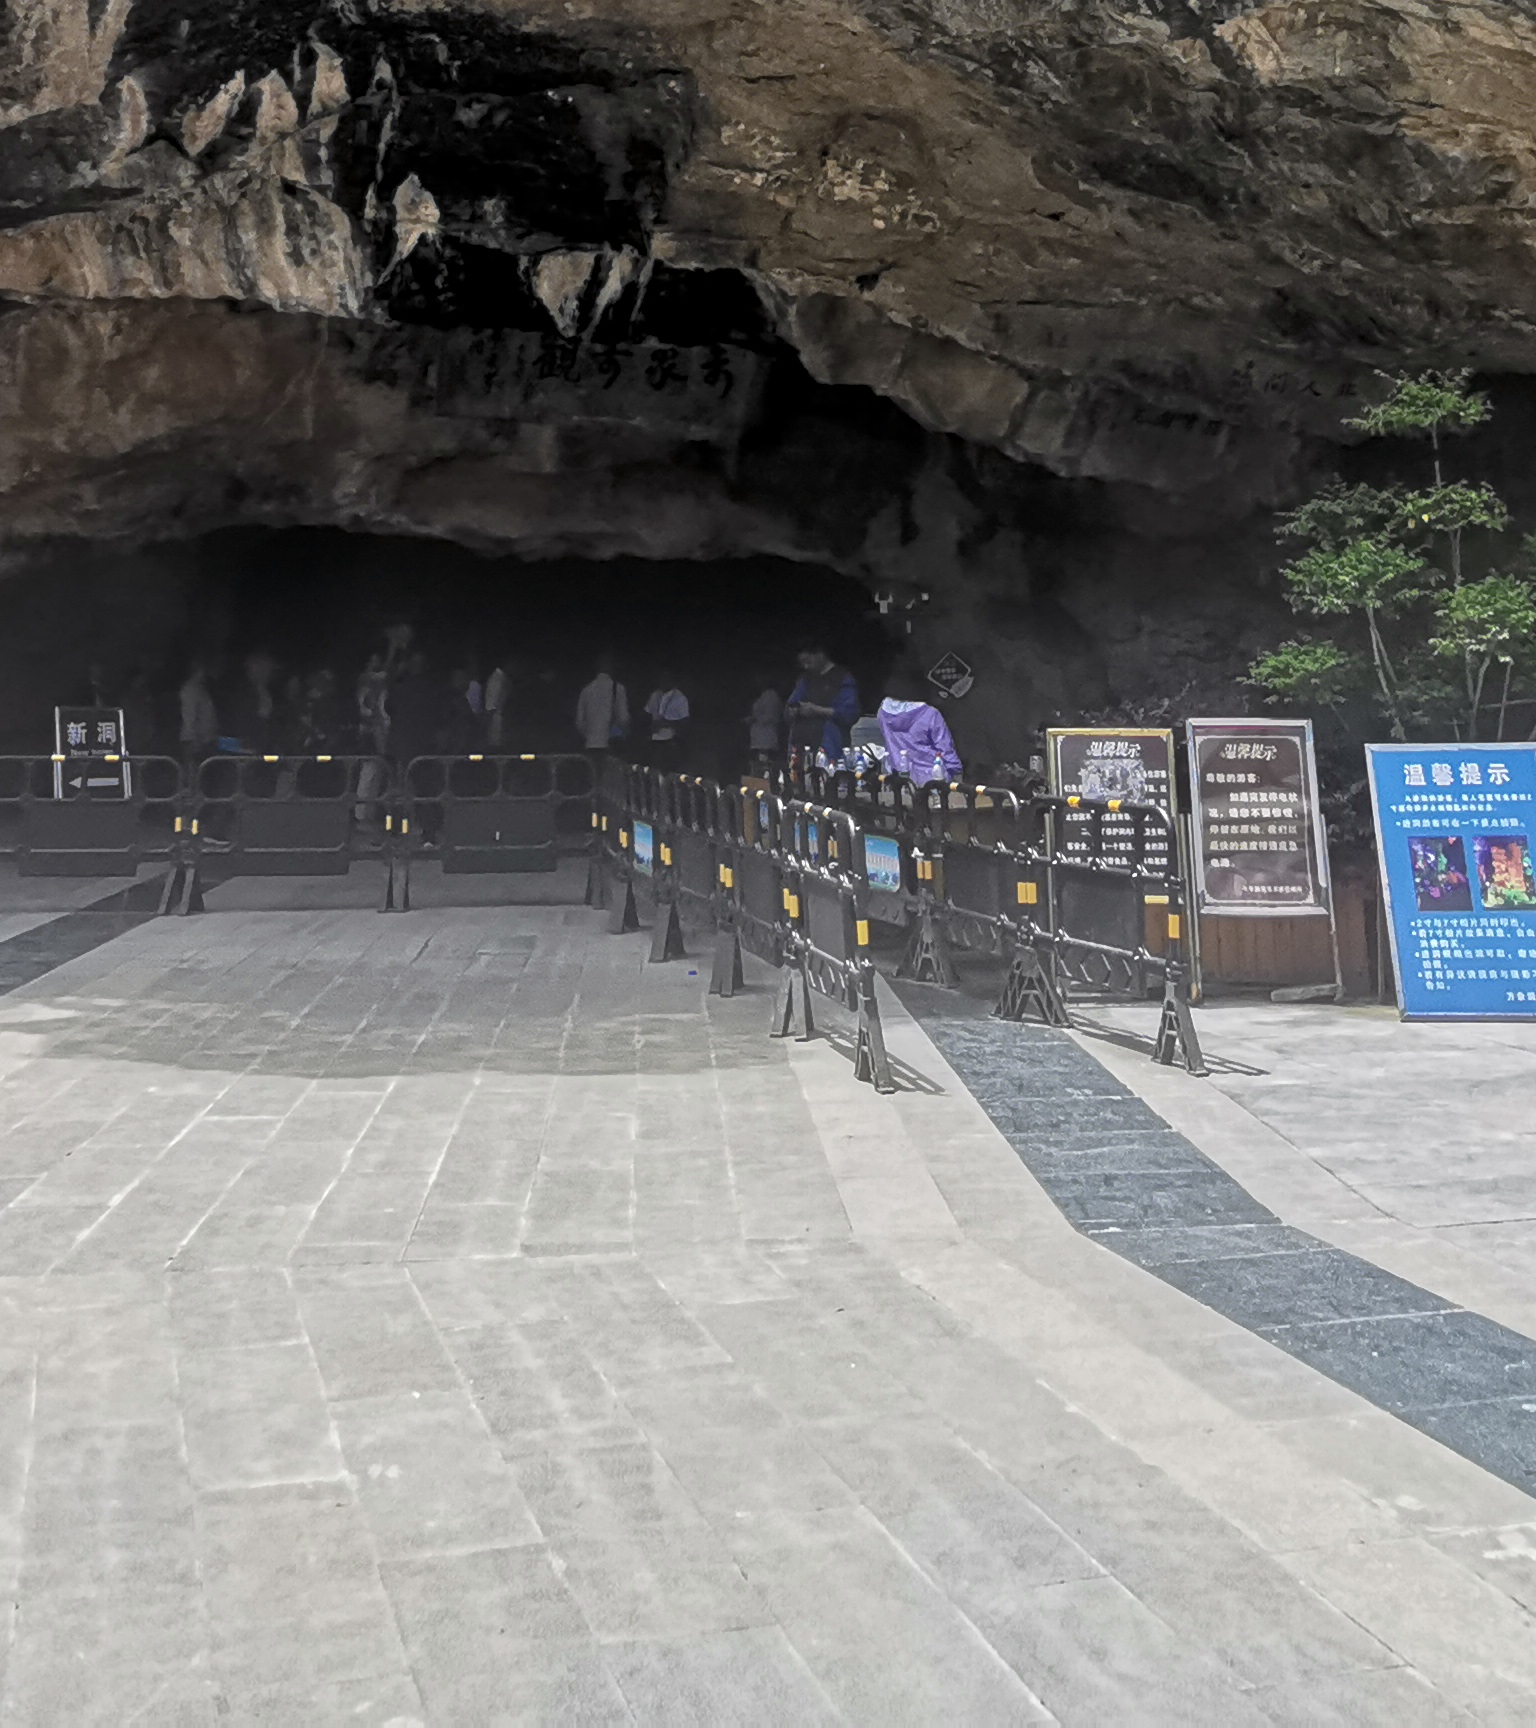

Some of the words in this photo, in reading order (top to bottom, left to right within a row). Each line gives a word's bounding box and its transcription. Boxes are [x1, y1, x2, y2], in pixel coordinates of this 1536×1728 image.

[66, 721, 117, 747] 新洞
[1086, 740, 1141, 758] 温馨提示
[1220, 743, 1278, 762] 温馨提示
[1404, 762, 1510, 786] 温馨提示
